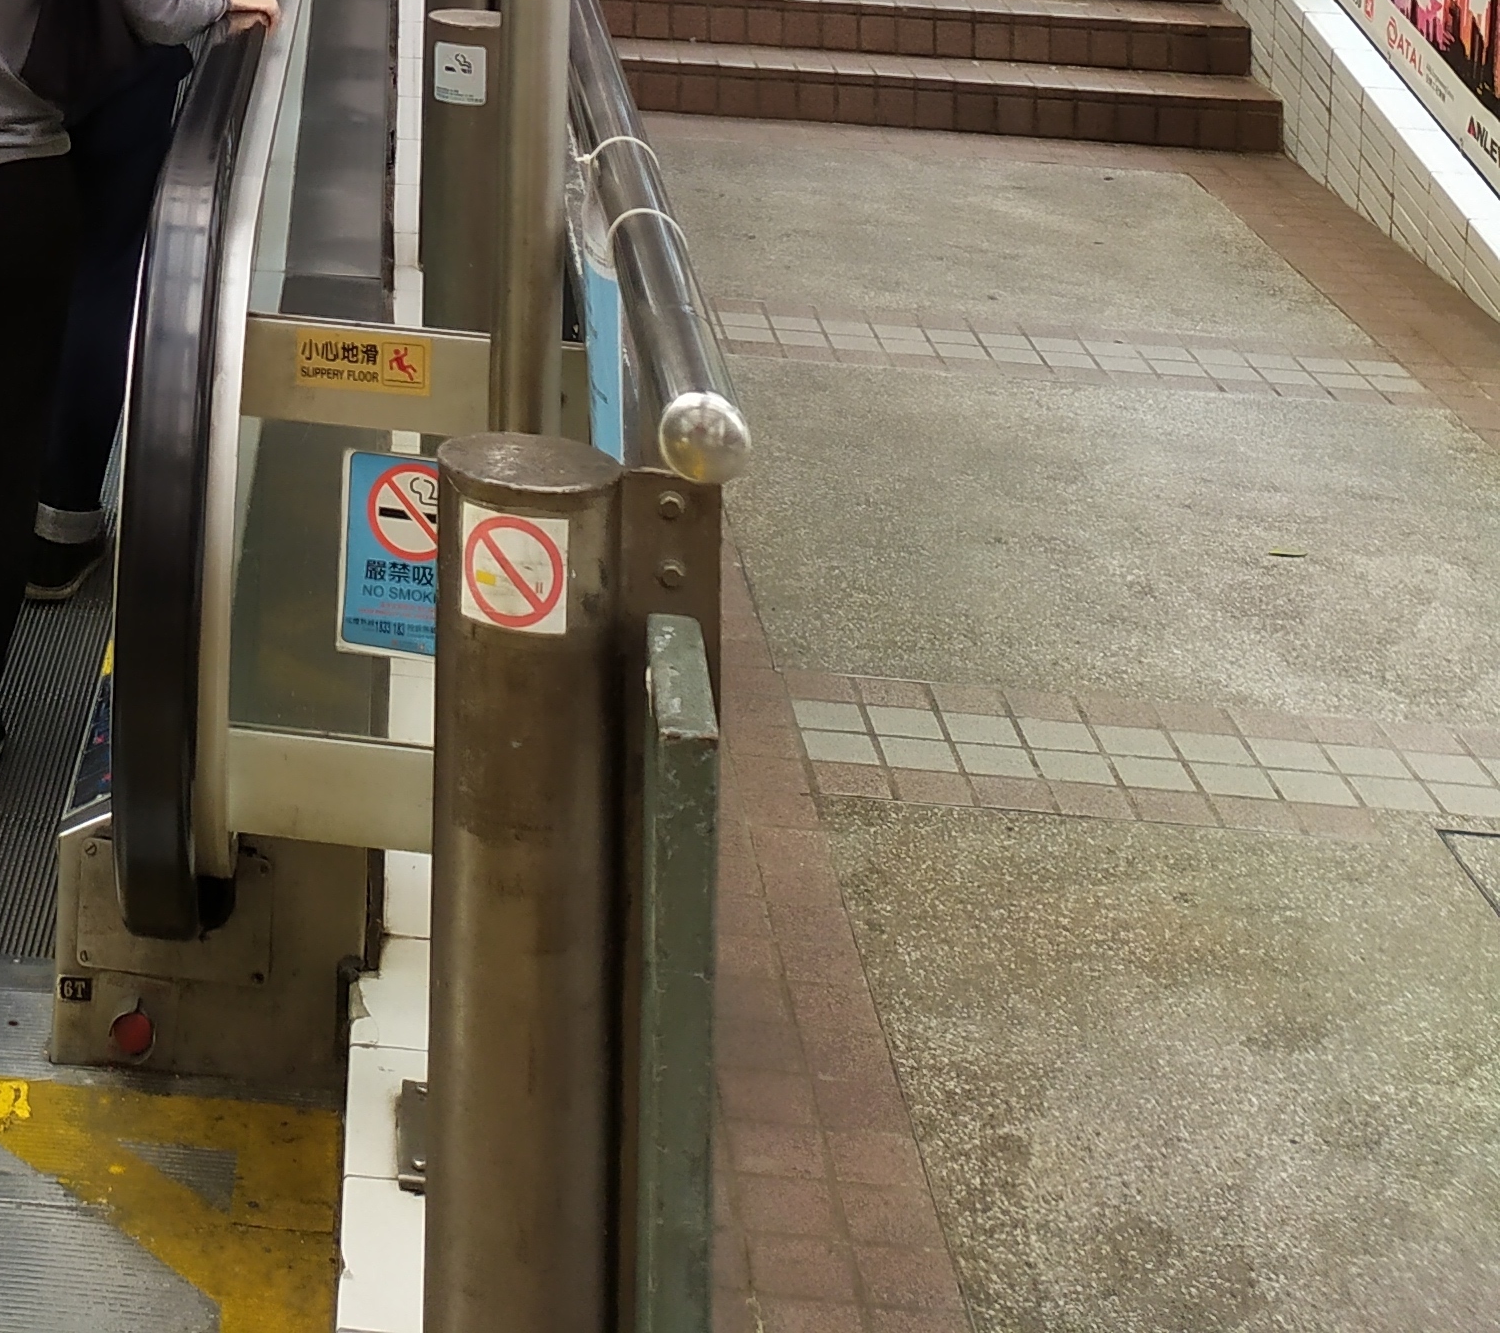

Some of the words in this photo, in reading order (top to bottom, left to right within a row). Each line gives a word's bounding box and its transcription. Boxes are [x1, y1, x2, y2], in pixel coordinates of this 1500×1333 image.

[301, 338, 379, 367] 小心地滑
[301, 366, 344, 381] SLIPPERY
[347, 369, 379, 384] FLOOR
[365, 559, 435, 588] 嚴禁吸
[362, 584, 384, 598] NO
[388, 586, 437, 604] SMOKI
